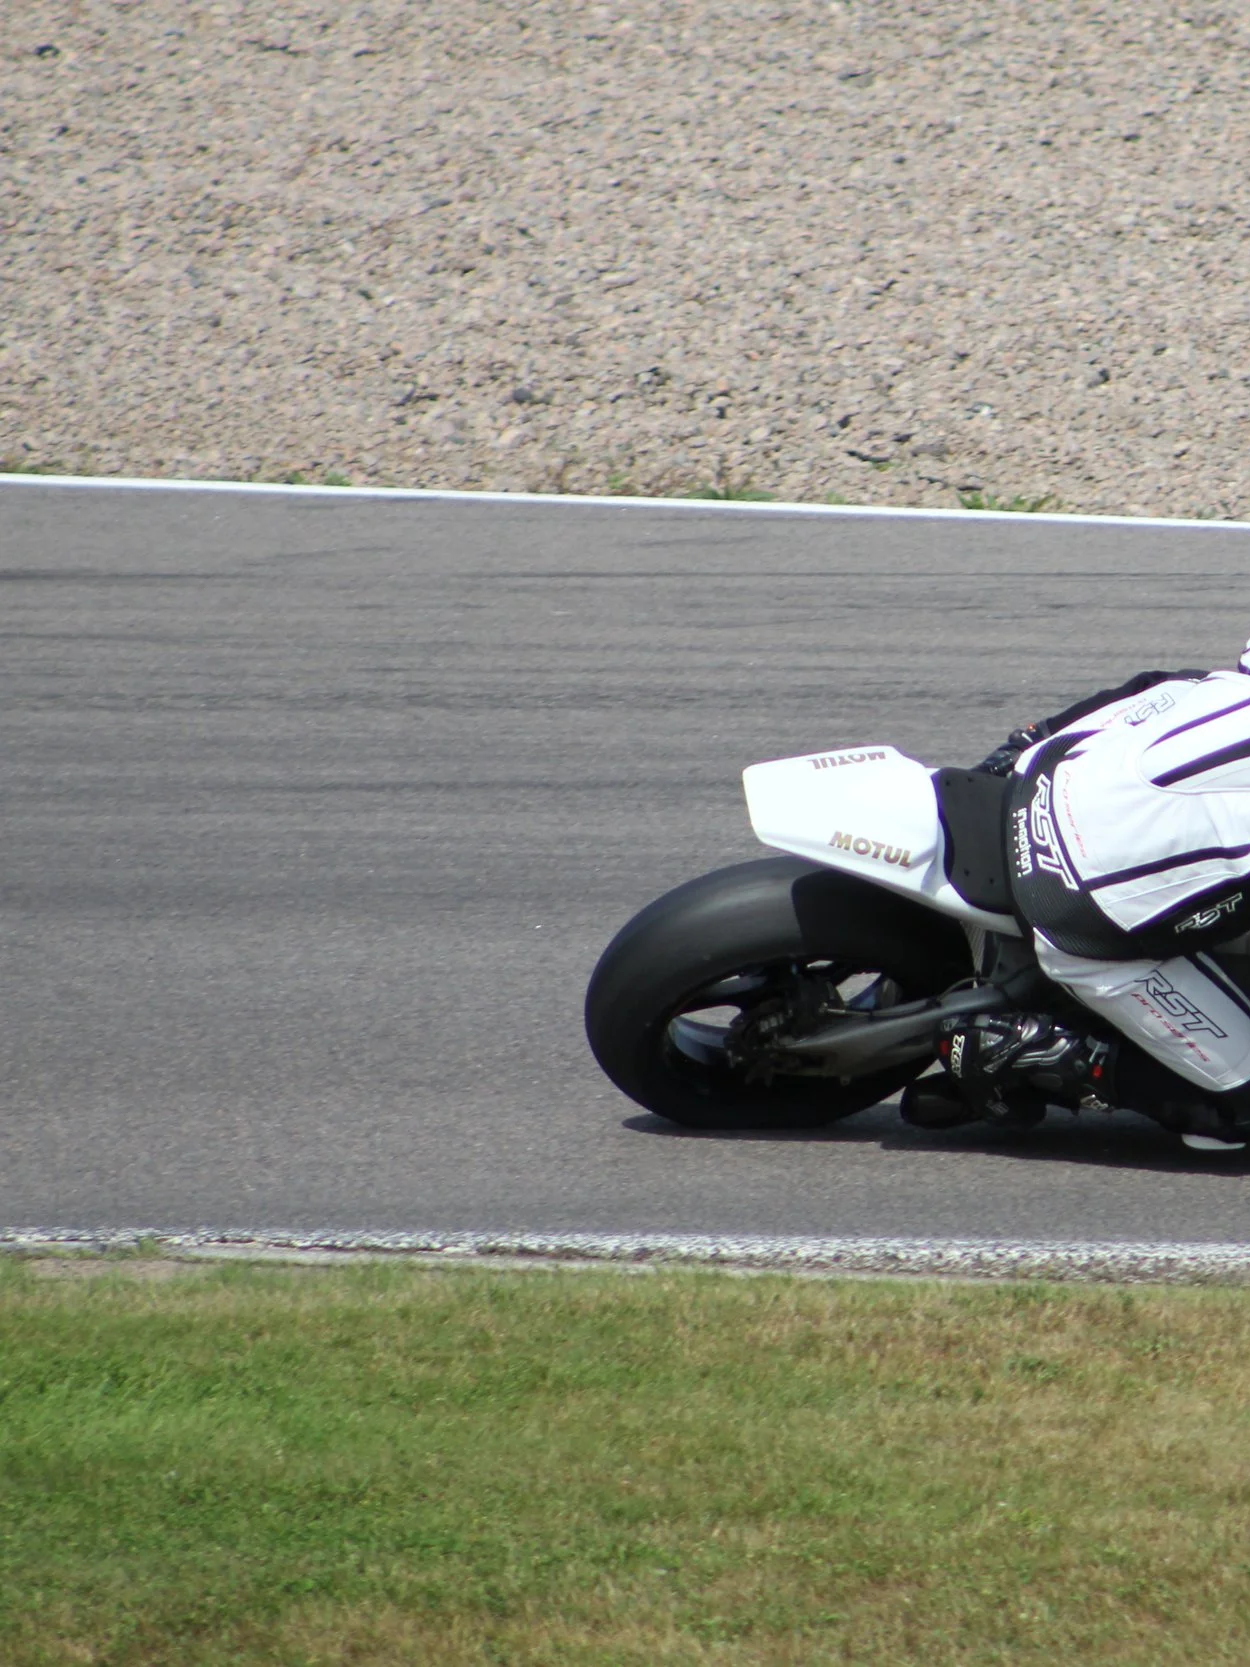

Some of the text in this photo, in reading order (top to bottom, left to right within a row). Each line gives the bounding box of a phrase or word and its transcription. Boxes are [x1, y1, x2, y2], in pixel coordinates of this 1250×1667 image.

[806, 751, 887, 770] MOTUL
[828, 831, 912, 868] MOTUL
[1030, 773, 1080, 891] RST
[1174, 892, 1243, 934] RST
[1134, 969, 1229, 1039] RST
